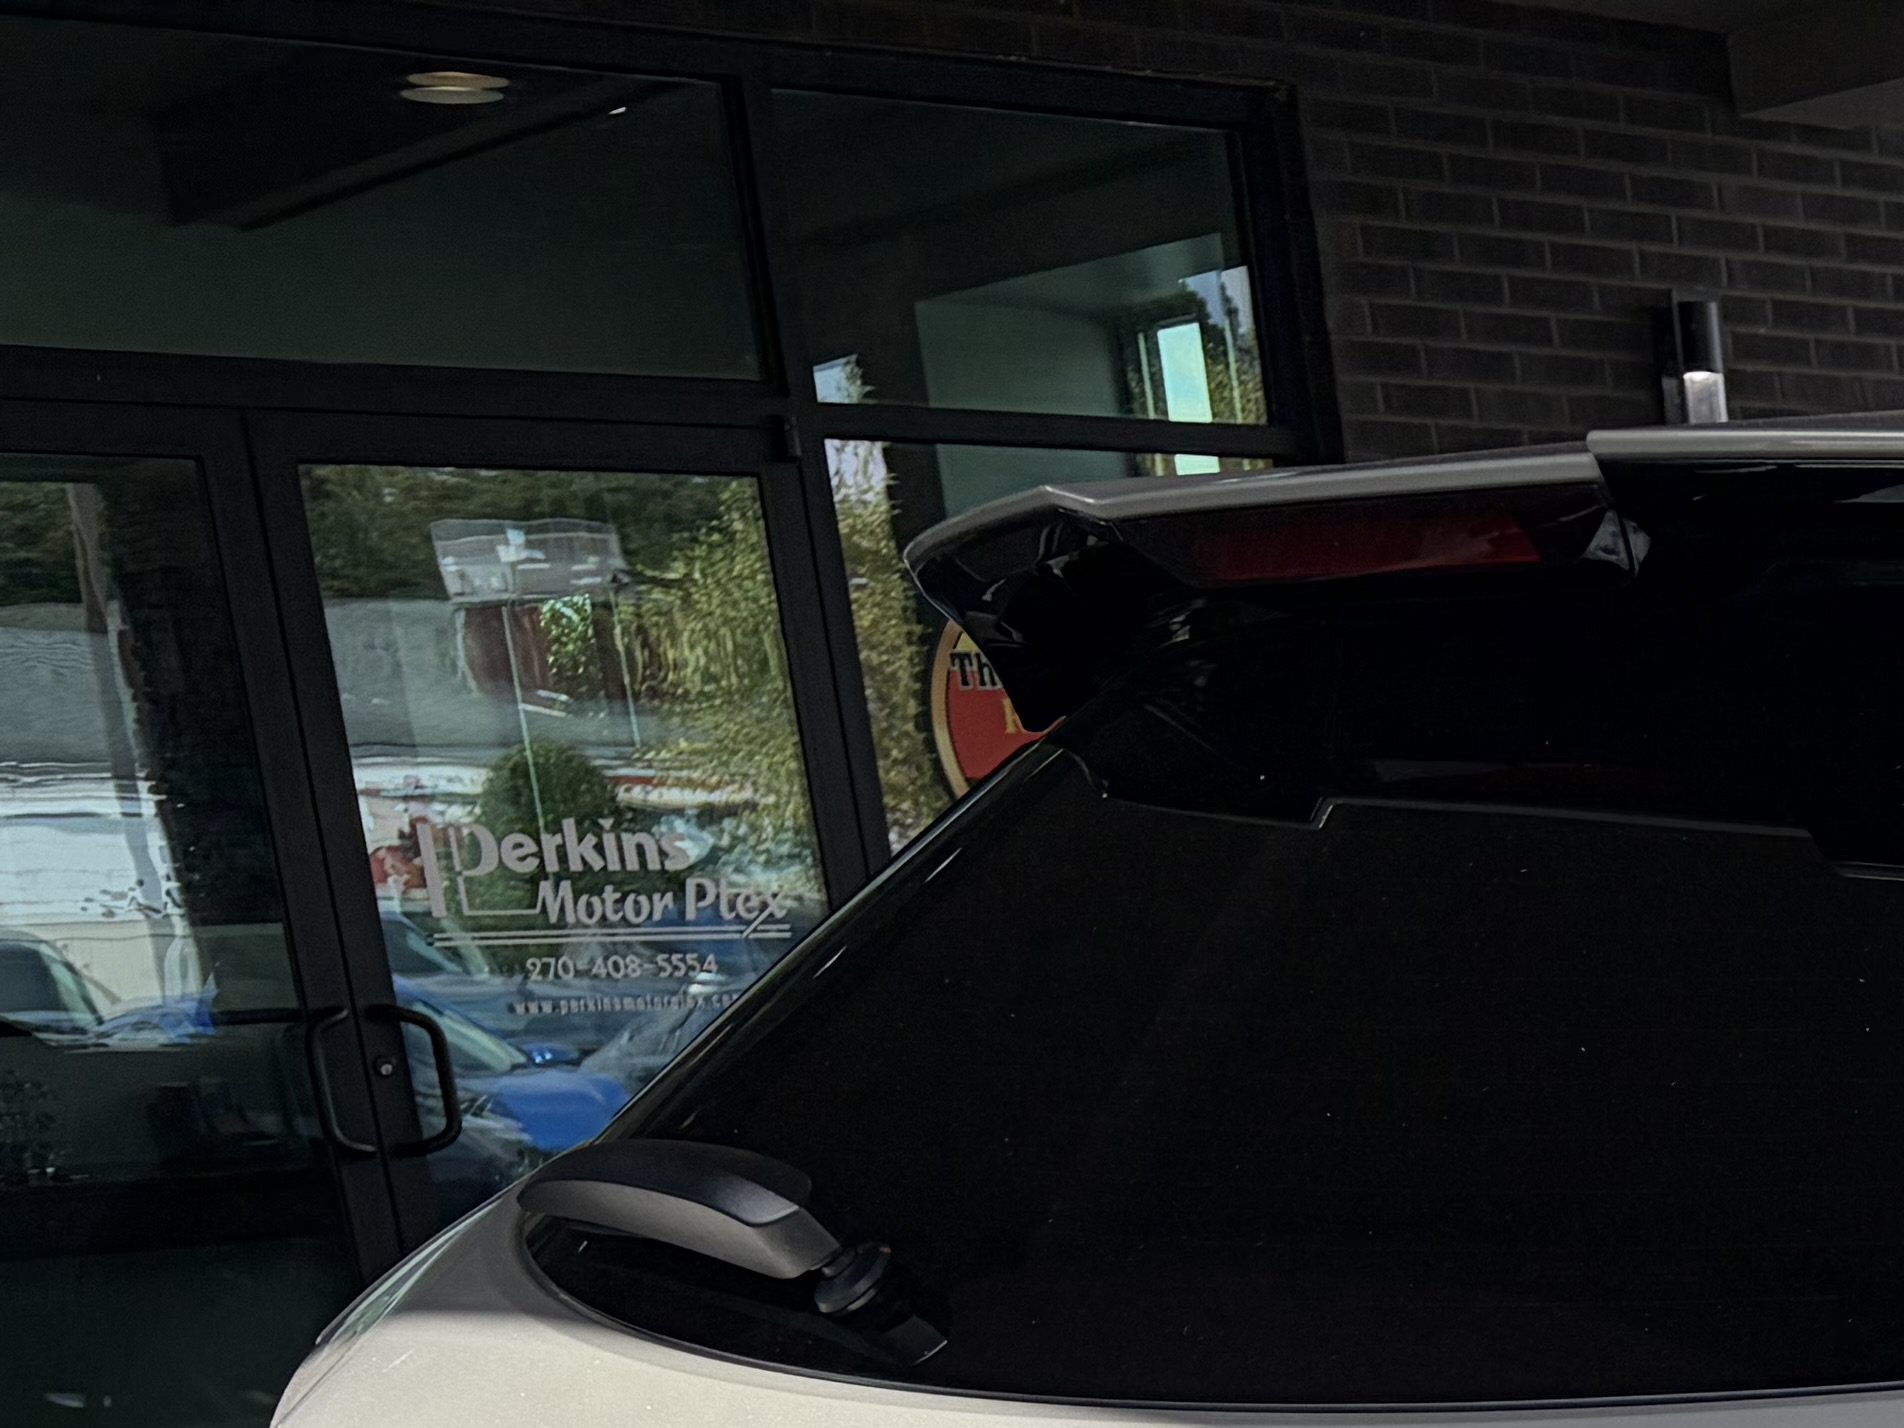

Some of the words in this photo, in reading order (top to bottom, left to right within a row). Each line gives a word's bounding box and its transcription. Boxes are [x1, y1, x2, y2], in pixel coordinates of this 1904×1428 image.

[949, 651, 1003, 688] Th
[416, 817, 692, 917] Perkins
[537, 878, 673, 926] Motor
[685, 876, 791, 938] Plex
[525, 952, 720, 982] 270-408-5554
